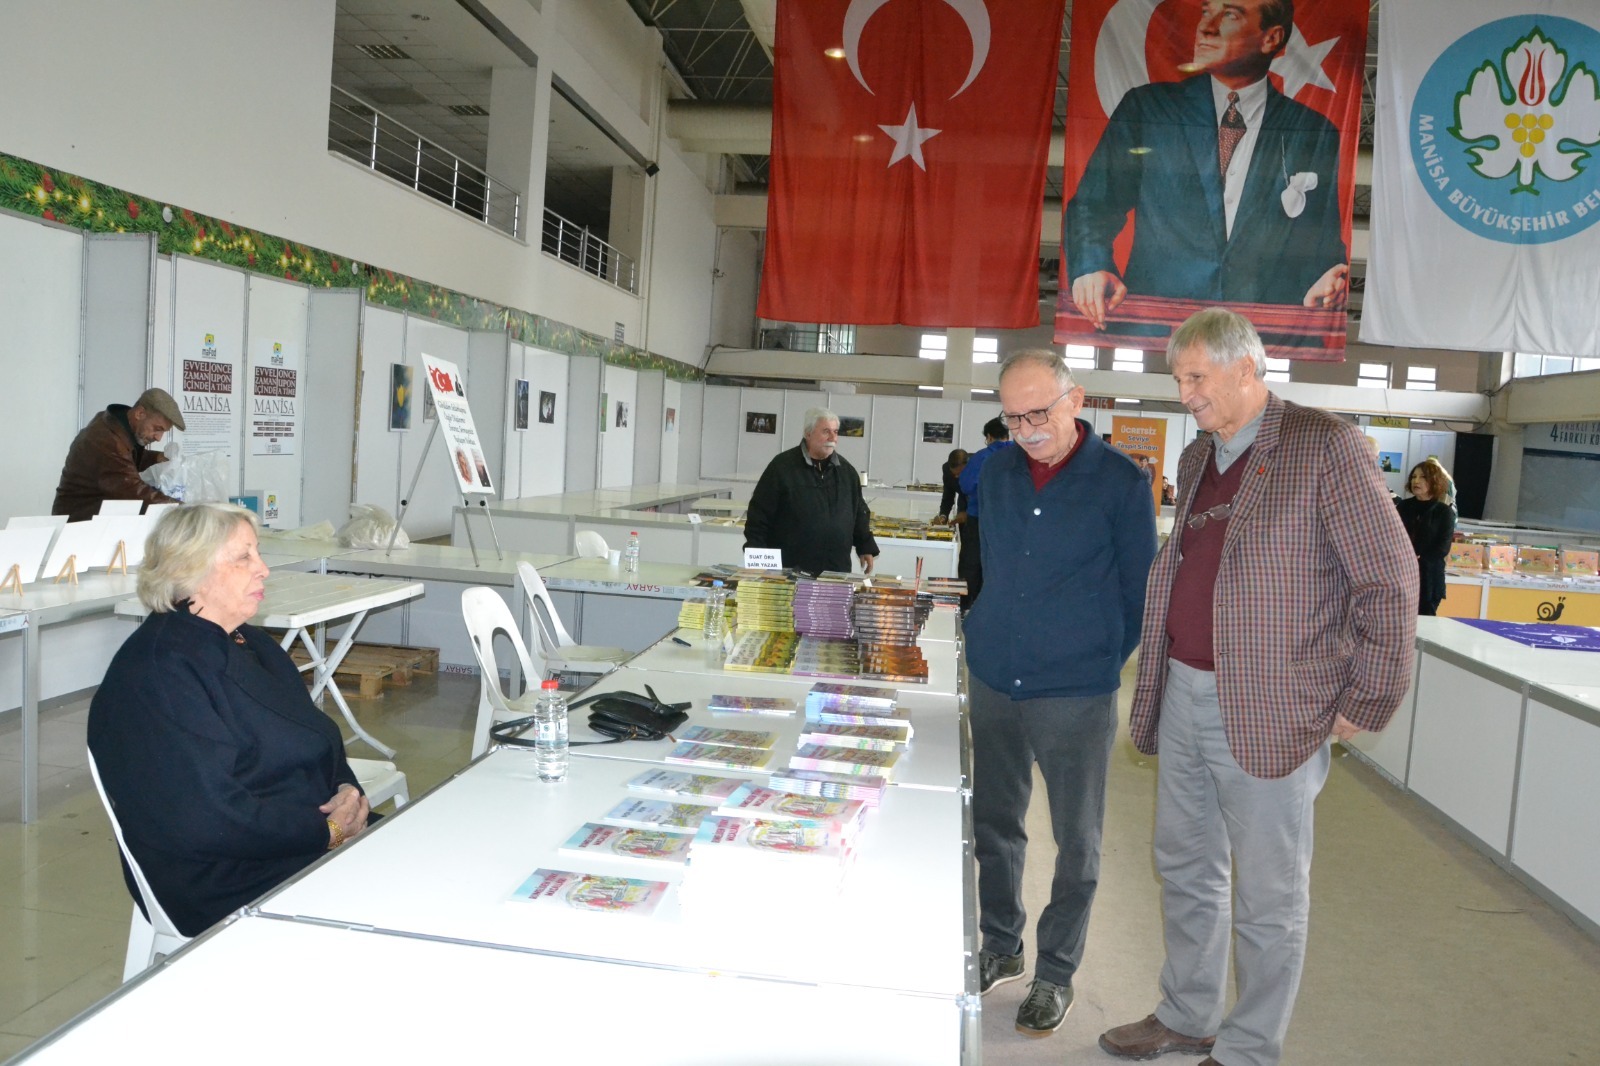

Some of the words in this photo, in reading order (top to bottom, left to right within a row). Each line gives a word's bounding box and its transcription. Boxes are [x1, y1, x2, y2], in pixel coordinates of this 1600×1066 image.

[1419, 114, 1450, 191] MANİSA
[1448, 188, 1570, 235] BÜYÜKŞEHİR
[184, 361, 209, 372] EVVEL
[211, 363, 232, 374] ONCE
[184, 371, 209, 380] ZAMAN
[211, 373, 232, 382] UPON
[255, 368, 276, 377] EVVEL
[278, 370, 296, 379] ONCE
[255, 376, 276, 386] ZAMAN
[278, 379, 296, 388] UPON
[183, 394, 231, 412] MANİSA
[254, 398, 294, 414] MANİSA
[1121, 425, 1156, 435] ÜCRETSİZ
[1550, 424, 1558, 442] 4
[1560, 432, 1586, 444] FARKLI
[626, 584, 660, 592] SARAY
[446, 665, 472, 674] SARAY
